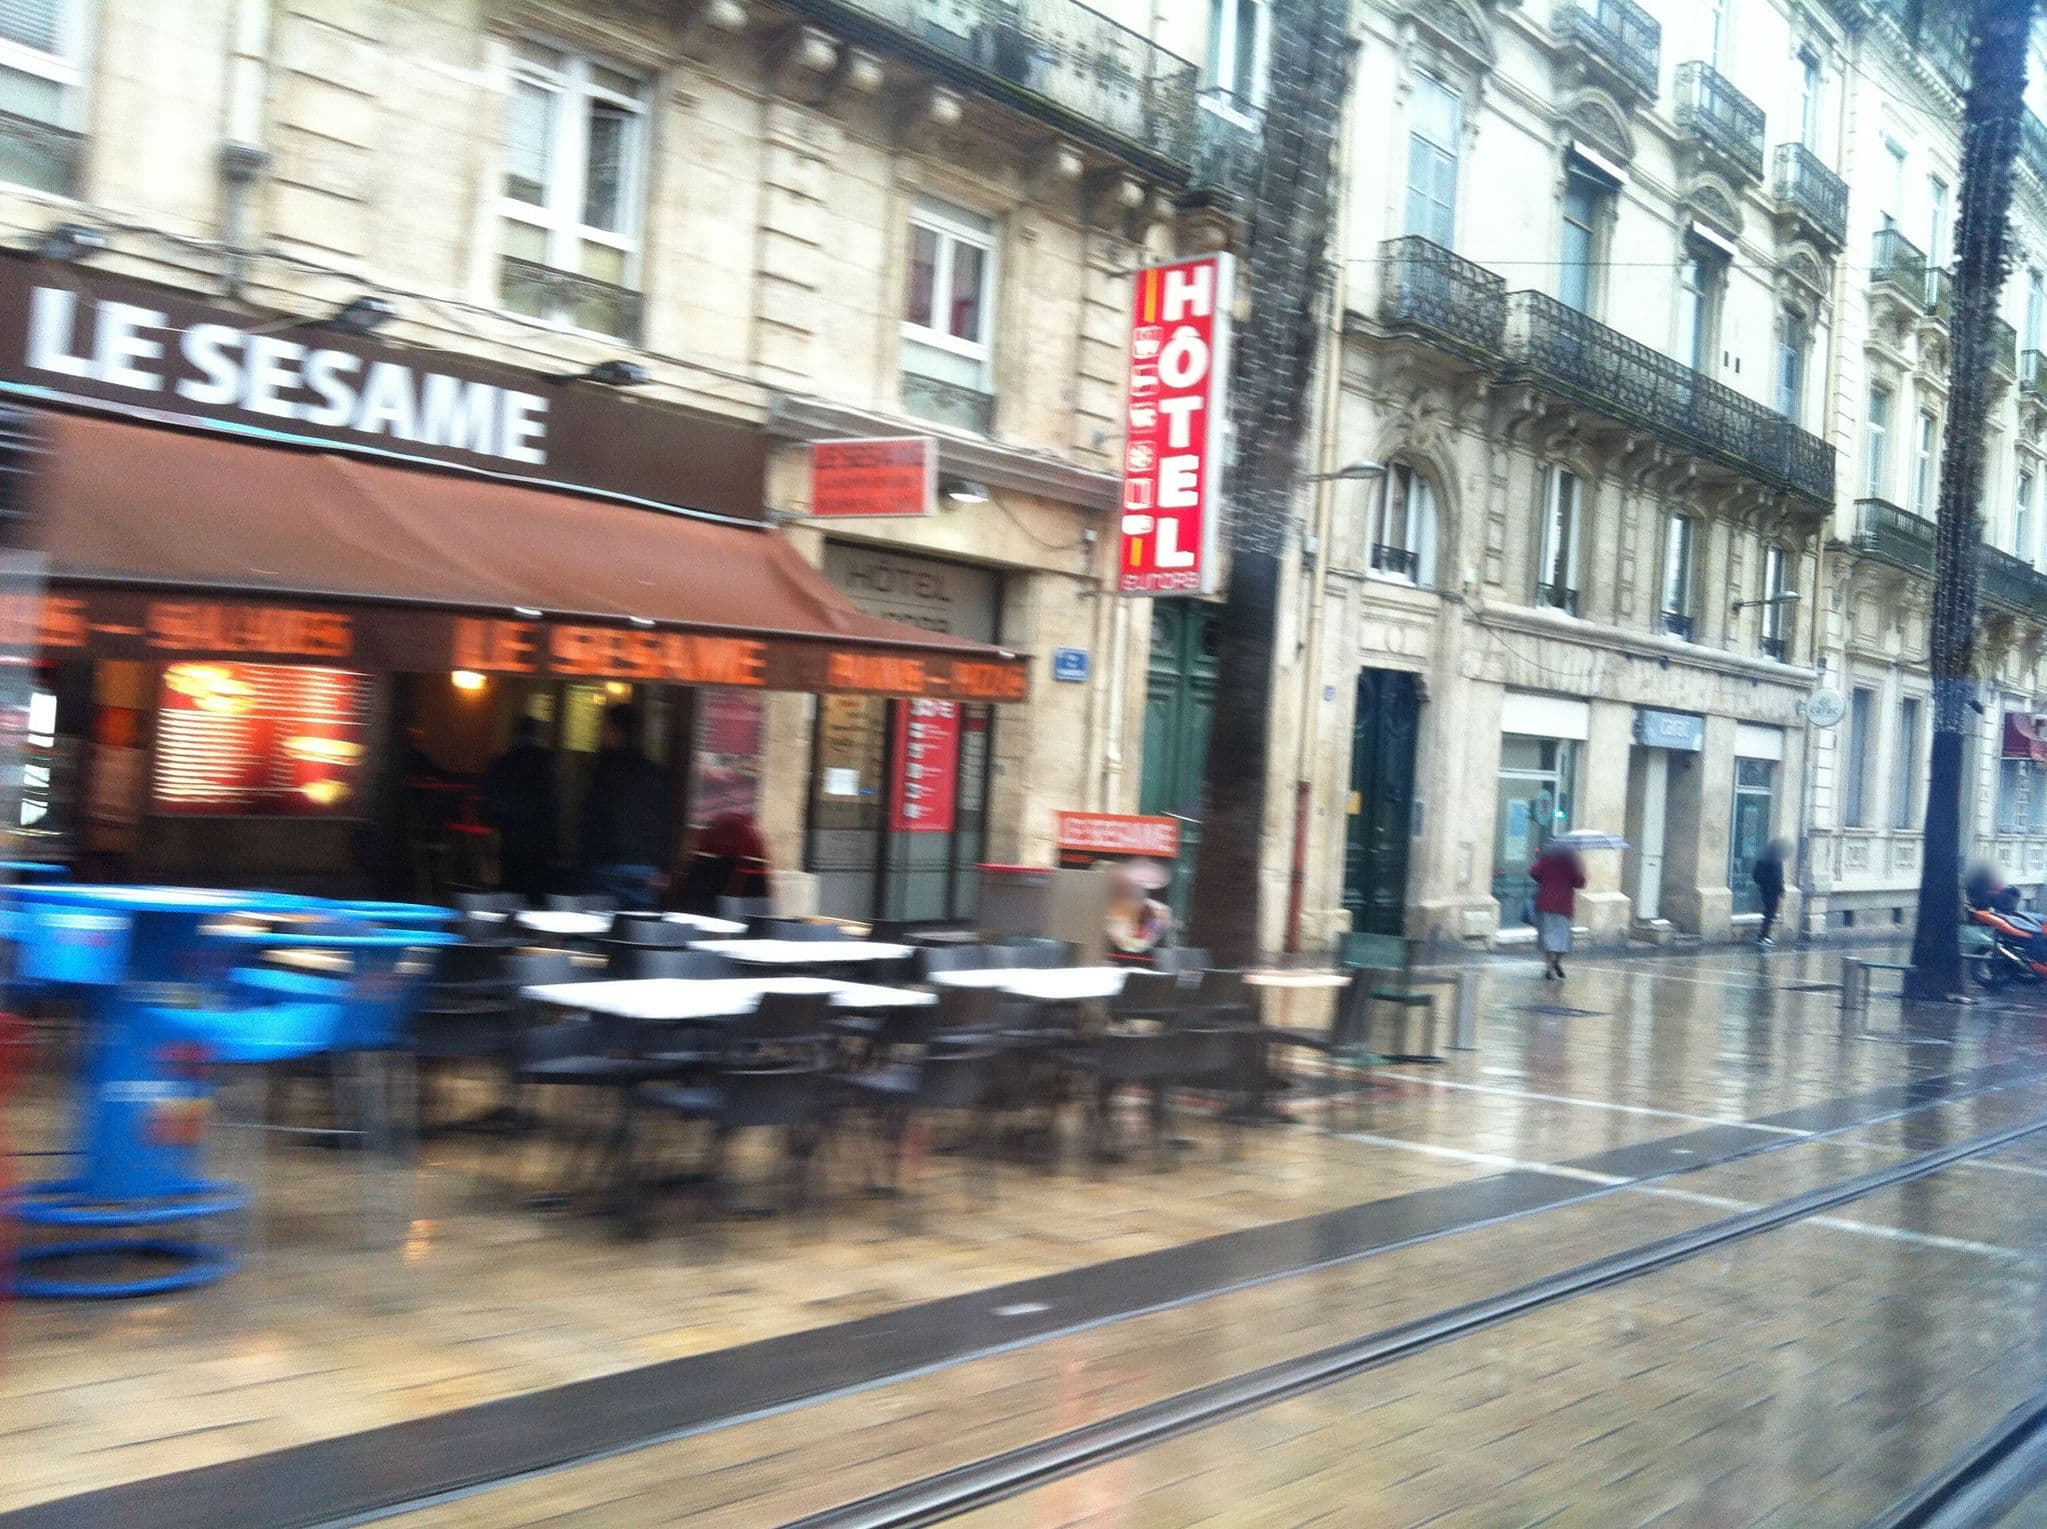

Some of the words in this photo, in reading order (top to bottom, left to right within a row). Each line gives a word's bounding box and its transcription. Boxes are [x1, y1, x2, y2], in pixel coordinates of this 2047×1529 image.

[24, 286, 168, 392] LE
[175, 322, 550, 465] SESAME
[1154, 264, 1213, 569] HÔTEL
[451, 617, 537, 673] LE
[548, 624, 768, 686] SESAME
